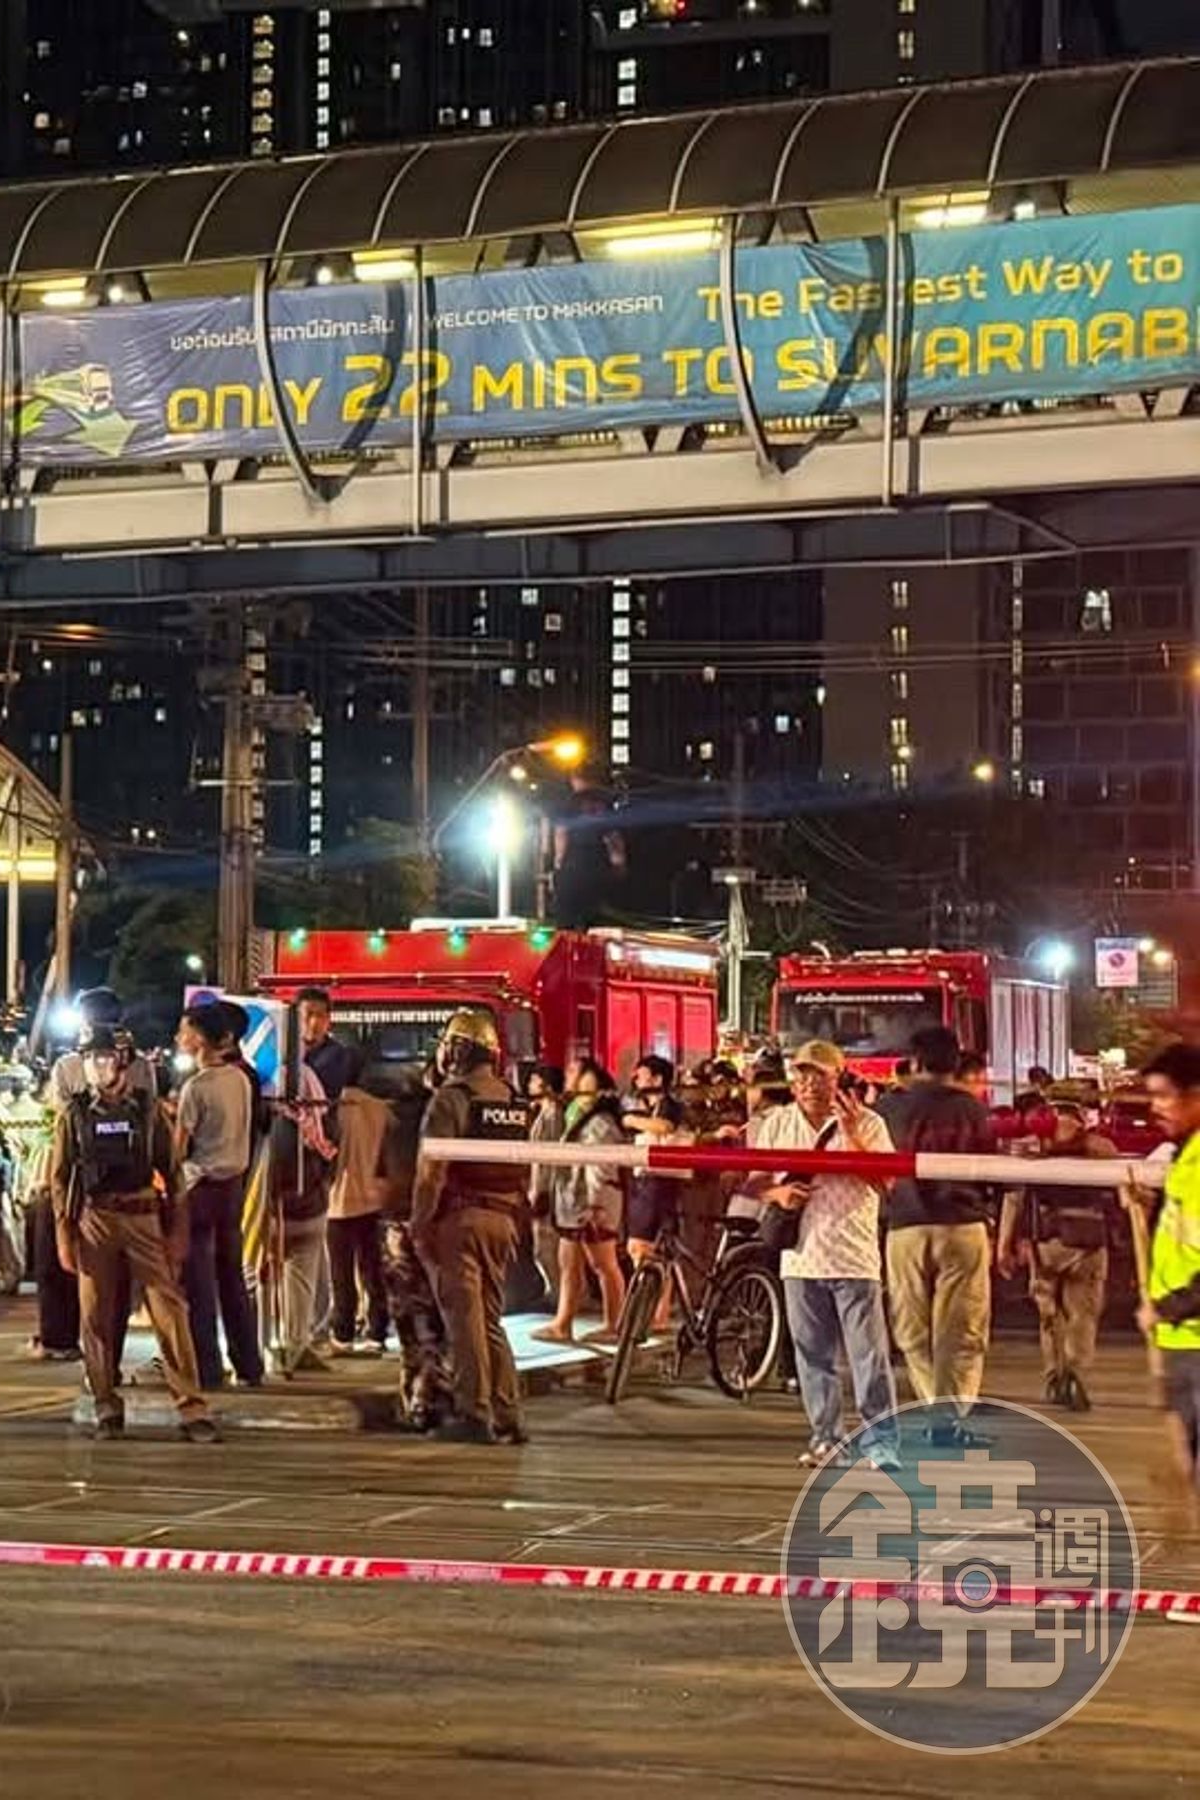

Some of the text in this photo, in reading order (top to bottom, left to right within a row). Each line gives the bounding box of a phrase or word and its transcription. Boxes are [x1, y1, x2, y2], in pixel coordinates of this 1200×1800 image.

[799, 264, 987, 314] Fasest
[1002, 255, 1112, 298] Way
[1128, 248, 1183, 284] to
[522, 304, 548, 320] TO
[553, 295, 664, 320] MAKKASAN
[342, 350, 450, 422] 22
[472, 353, 643, 412] MINS
[663, 345, 753, 396] TO
[482, 1108, 527, 1125] POLICE
